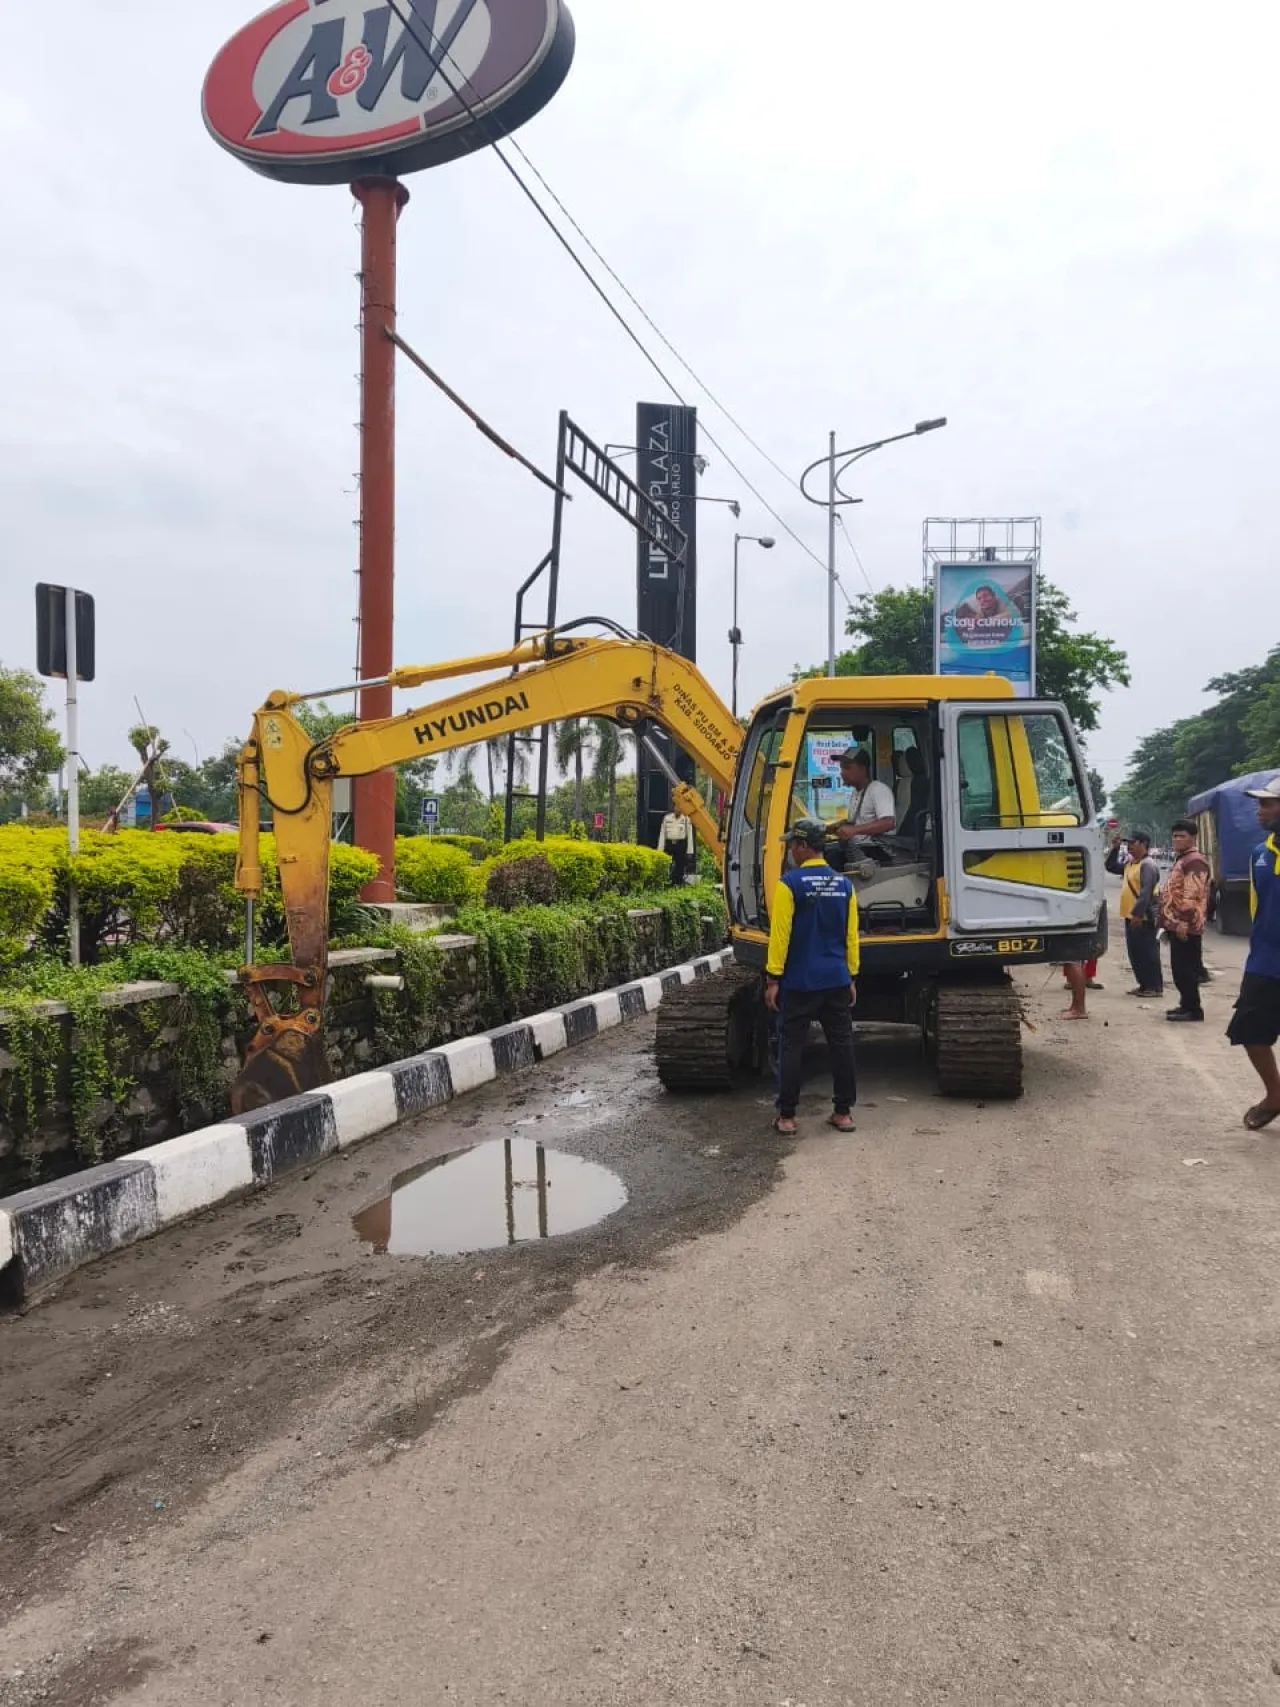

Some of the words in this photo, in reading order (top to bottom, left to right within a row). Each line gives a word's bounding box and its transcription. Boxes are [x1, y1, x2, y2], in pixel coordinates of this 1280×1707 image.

[249, 0, 478, 136] A&W
[649, 421, 668, 496] PLAZA
[671, 463, 681, 531] IDOARJO
[944, 616, 975, 630] Stay
[413, 691, 529, 745] HYUNDAI
[673, 684, 697, 711] DINAS
[693, 719, 731, 760] SIDOARJO
